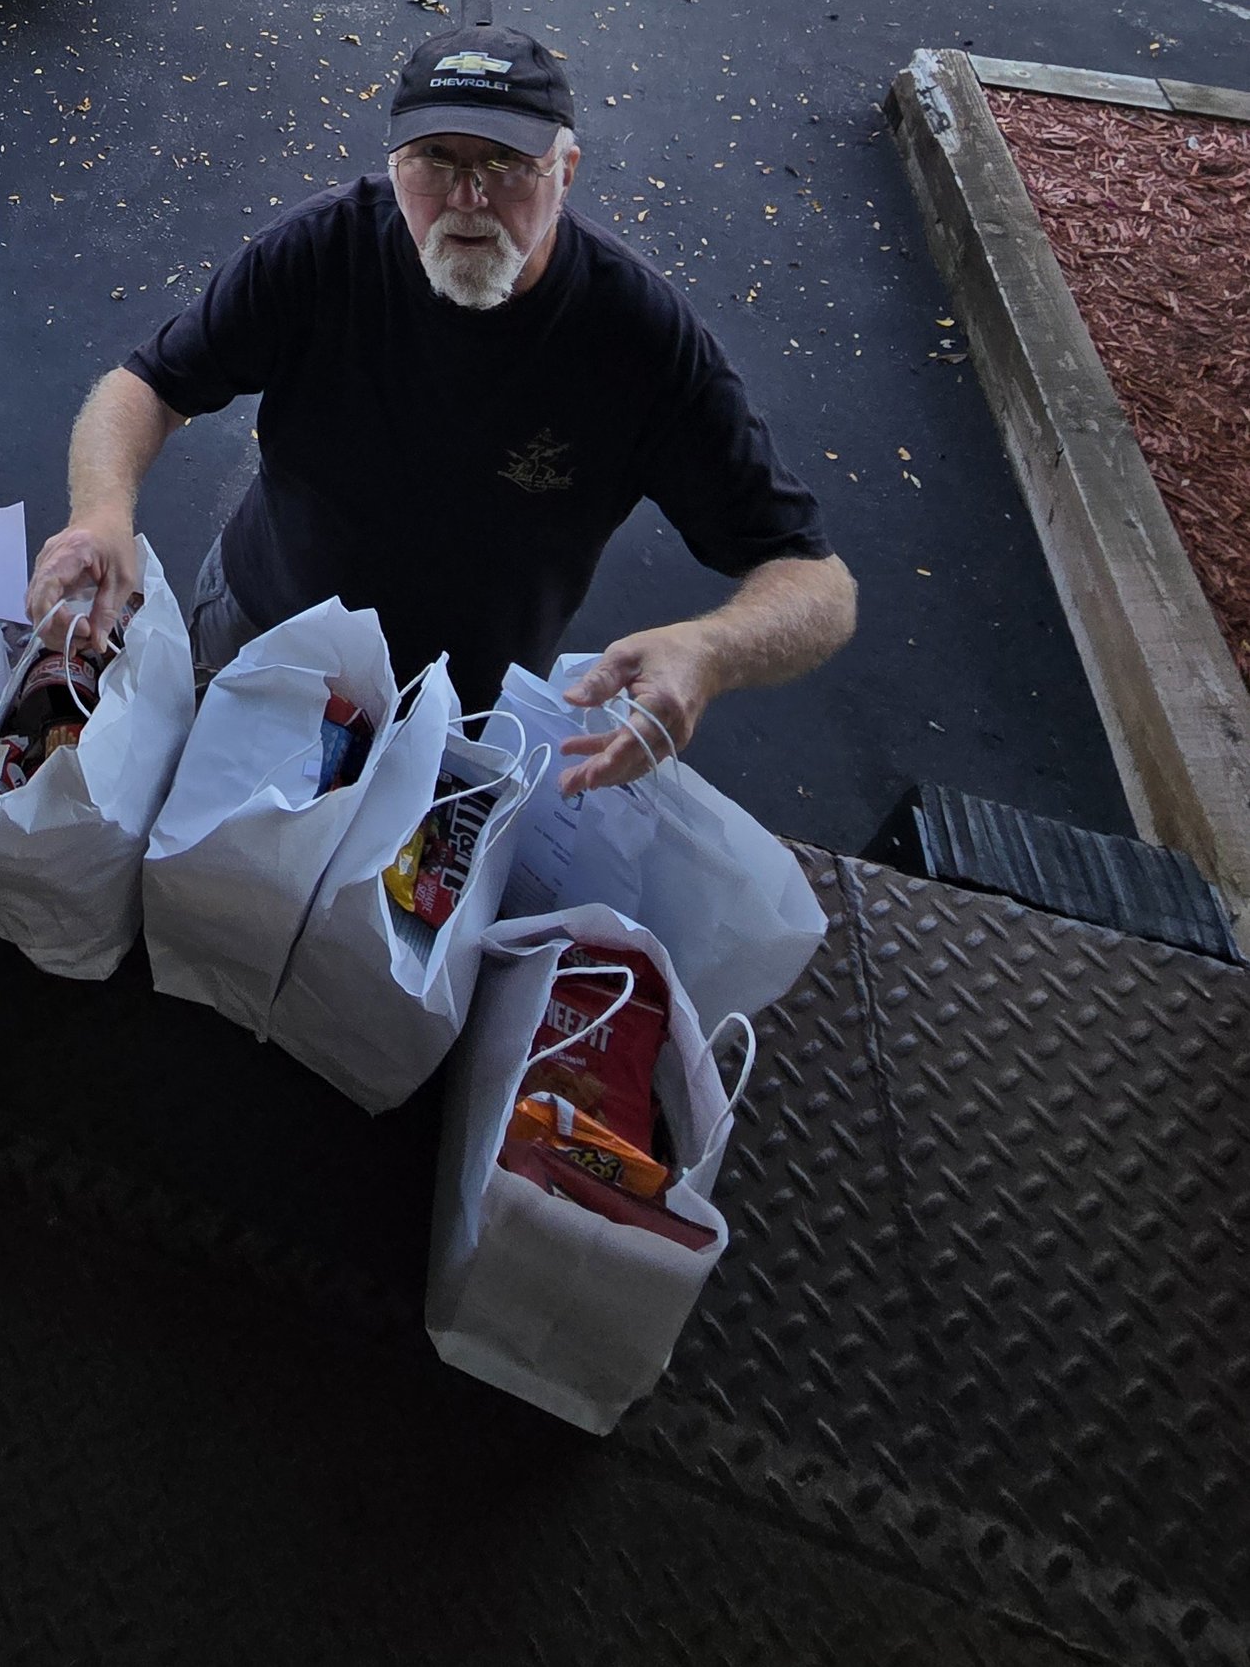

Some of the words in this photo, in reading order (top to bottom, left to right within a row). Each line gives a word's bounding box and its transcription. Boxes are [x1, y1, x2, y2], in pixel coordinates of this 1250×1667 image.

[430, 78, 511, 92] CHEVROLET
[415, 883, 426, 904] SIZE
[422, 883, 438, 915] SHARE
